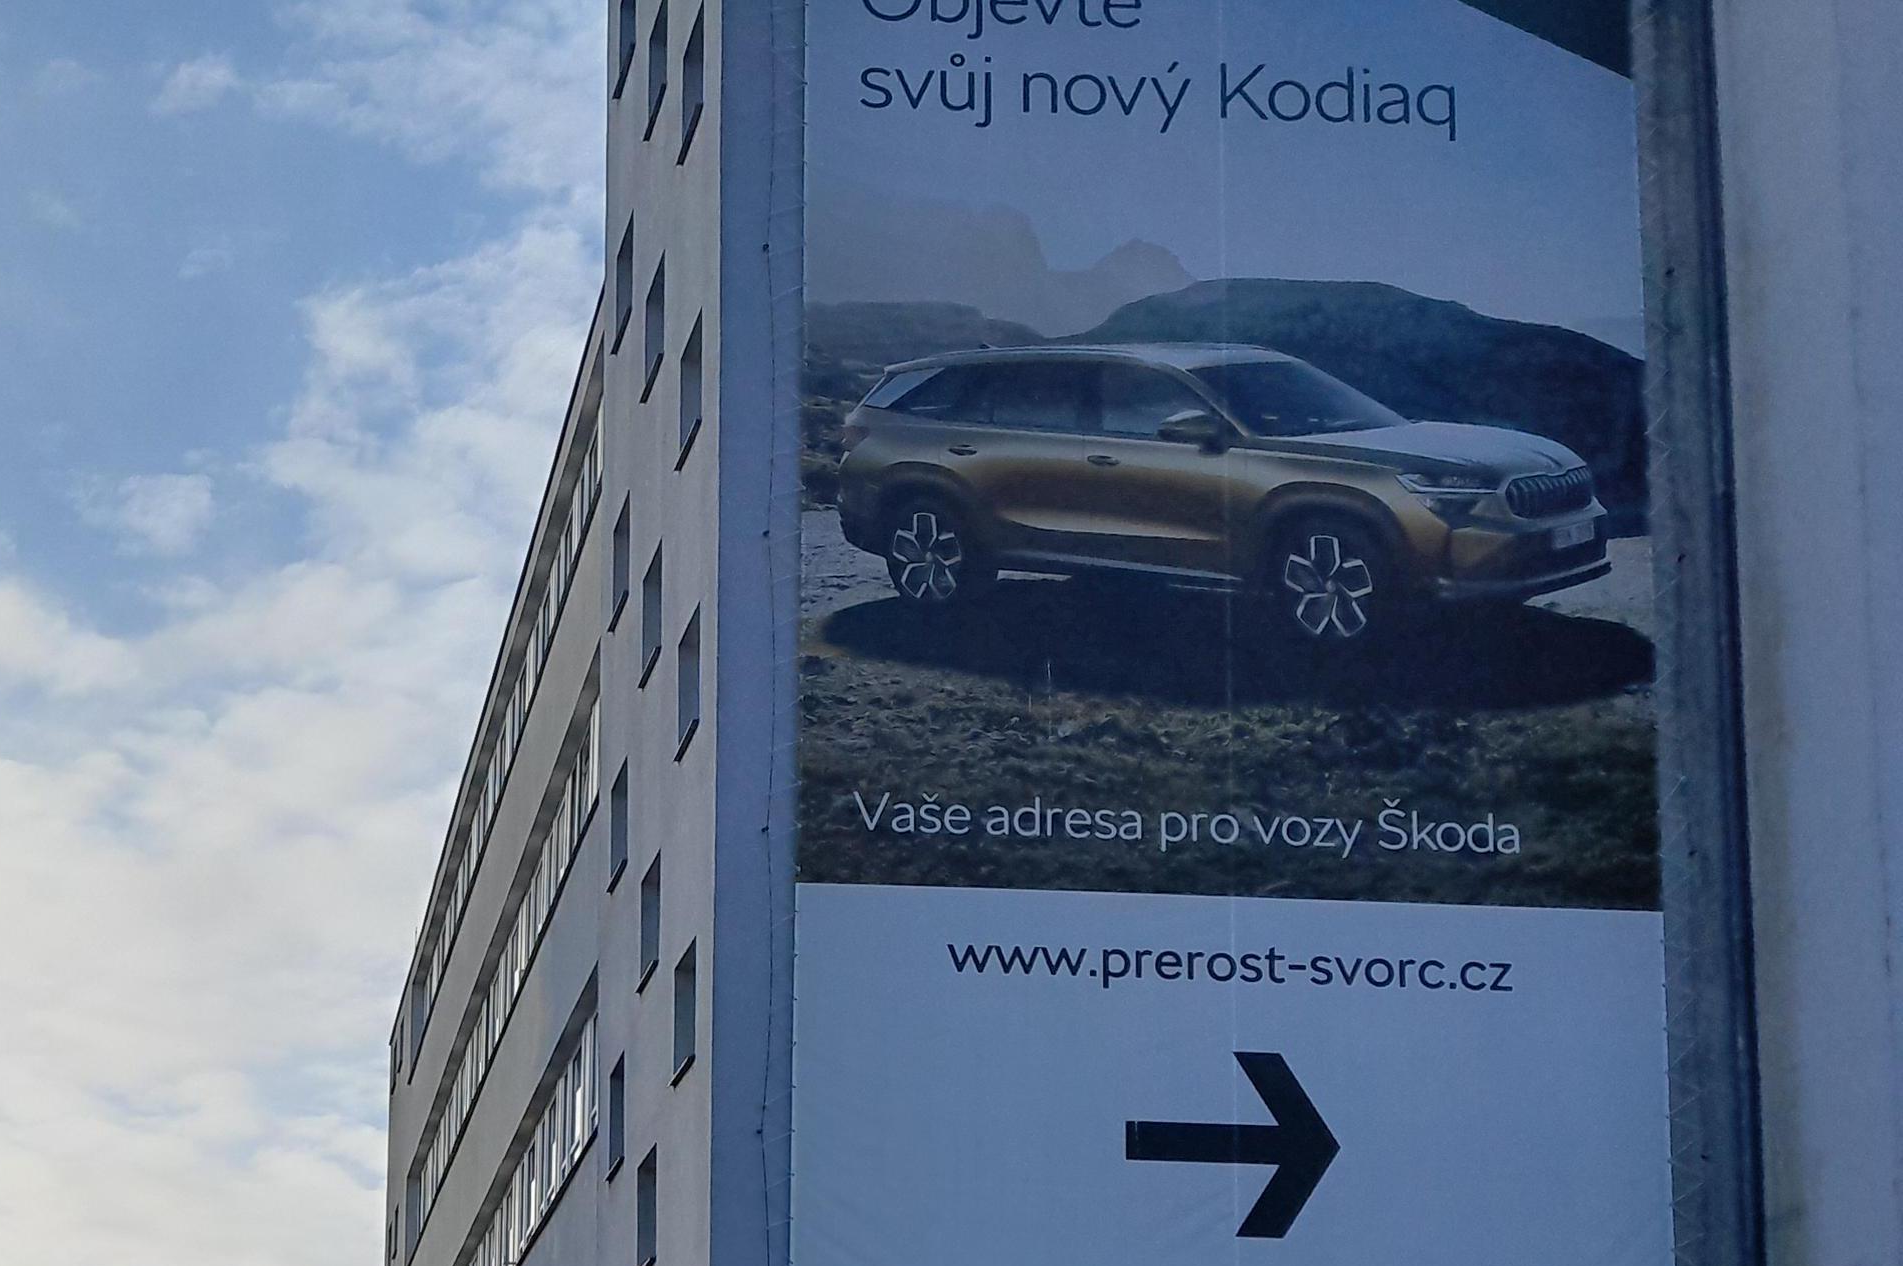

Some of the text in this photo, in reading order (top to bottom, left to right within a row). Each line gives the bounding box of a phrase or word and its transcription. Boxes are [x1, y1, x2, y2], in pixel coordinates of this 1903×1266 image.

[860, 53, 1456, 141] svůj nový Kodiaq
[853, 791, 1521, 858] Vaše adresa pro vozy Škoda
[947, 943, 1513, 992] www.prerost-svorc.cz
